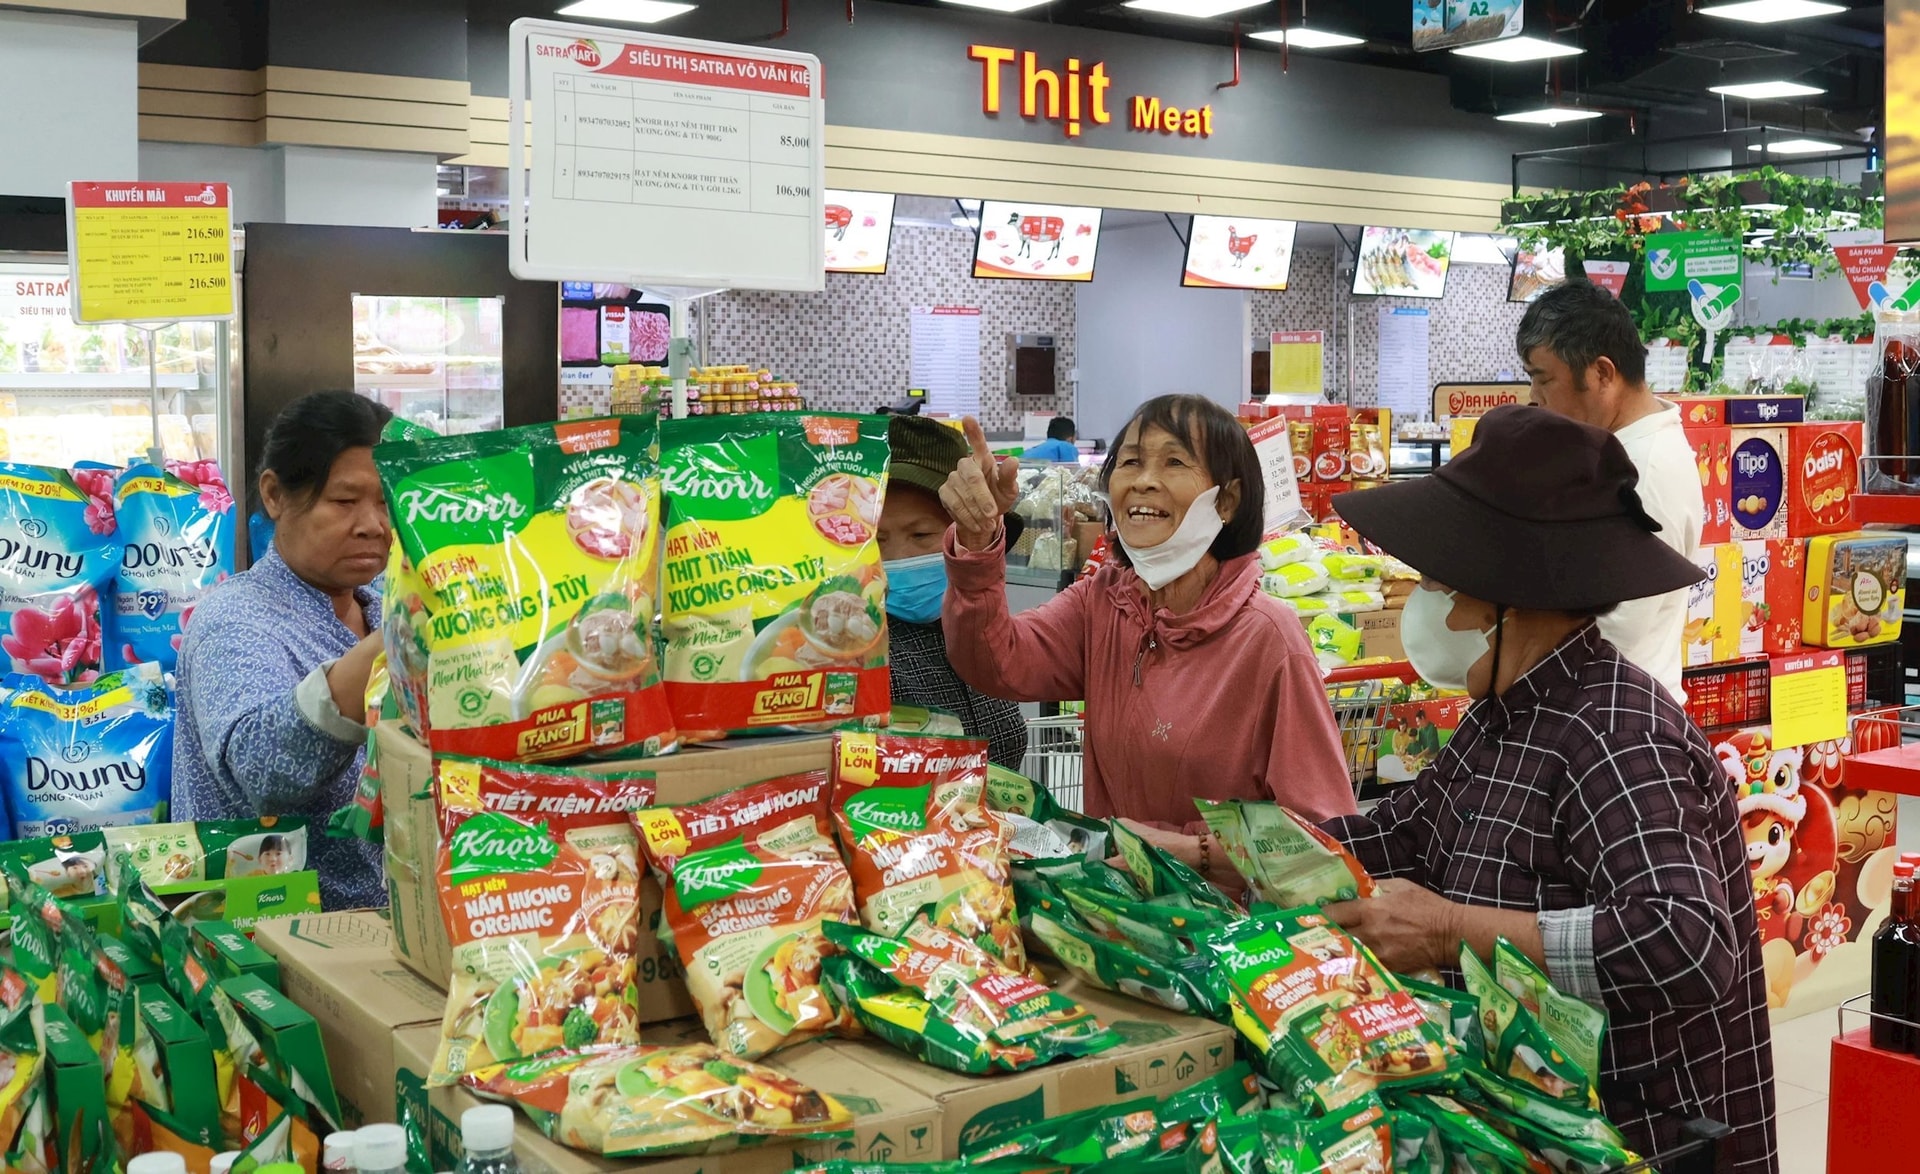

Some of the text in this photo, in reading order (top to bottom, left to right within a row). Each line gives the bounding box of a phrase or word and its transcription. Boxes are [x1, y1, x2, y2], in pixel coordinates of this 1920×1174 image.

[1469, 2, 1489, 16] A2
[629, 50, 811, 87] SIÊU THỊ SATRA VÕ VĂN KIỆ
[967, 44, 1213, 136] Thịt Meat
[635, 117, 661, 127] KNORR
[663, 120, 679, 129] HẠT
[699, 123, 716, 134] THỊT
[683, 131, 689, 139] &
[634, 169, 650, 179] HẠT
[671, 172, 698, 181] KNORR
[699, 173, 716, 184] THỊT
[105, 186, 166, 203] KHUYẾN MÃI
[187, 228, 224, 240] 216.500
[188, 252, 225, 264] 172.100
[189, 277, 226, 289] 216.500
[605, 311, 626, 319] VISSAN
[1466, 391, 1517, 408] BA HUÂN
[1757, 403, 1778, 418] Tipo
[1736, 450, 1765, 477] Tipo
[1805, 448, 1843, 478] Daisy
[659, 465, 774, 500] Knorr
[399, 488, 526, 524] Knorr
[667, 527, 722, 559] HẠT NÊM
[667, 546, 753, 584] THỊT THĂN
[1743, 555, 1770, 585] ipo
[669, 578, 735, 613] XƯƠNG
[794, 555, 826, 582] TỦY
[137, 590, 167, 611] 99%
[432, 603, 495, 641] XƯƠNG
[552, 573, 590, 602] TỦY
[762, 673, 823, 711] TẶNG 1
[773, 674, 802, 687] MUA
[526, 703, 588, 750] TẶNG 1
[535, 708, 567, 726] MUA
[845, 755, 872, 769] LỚN
[850, 745, 869, 756] GÓI
[26, 757, 146, 792] Downy
[27, 793, 65, 803] CHỐNG
[484, 790, 649, 818] TIẾT KIỆM HƠN!
[731, 802, 774, 827] KIỆM
[773, 785, 820, 813] HƠN!
[651, 818, 670, 829] GÓI
[847, 800, 922, 827] Knorr
[45, 823, 78, 837] 99%
[651, 828, 681, 843] LỚN
[449, 829, 554, 859] Knorr
[258, 892, 284, 903] Knorr
[460, 878, 507, 899] HẠT NÊM
[735, 887, 793, 914] HƯƠNG
[464, 884, 572, 919] NẤM HƯƠNG
[469, 907, 554, 938] ORGANIC
[707, 912, 779, 938] ORGANIC
[1224, 947, 1289, 975] Knorr
[1274, 980, 1318, 1010] ORGANIC
[1350, 1002, 1398, 1027] TẶNG
[1176, 1064, 1195, 1082] UP
